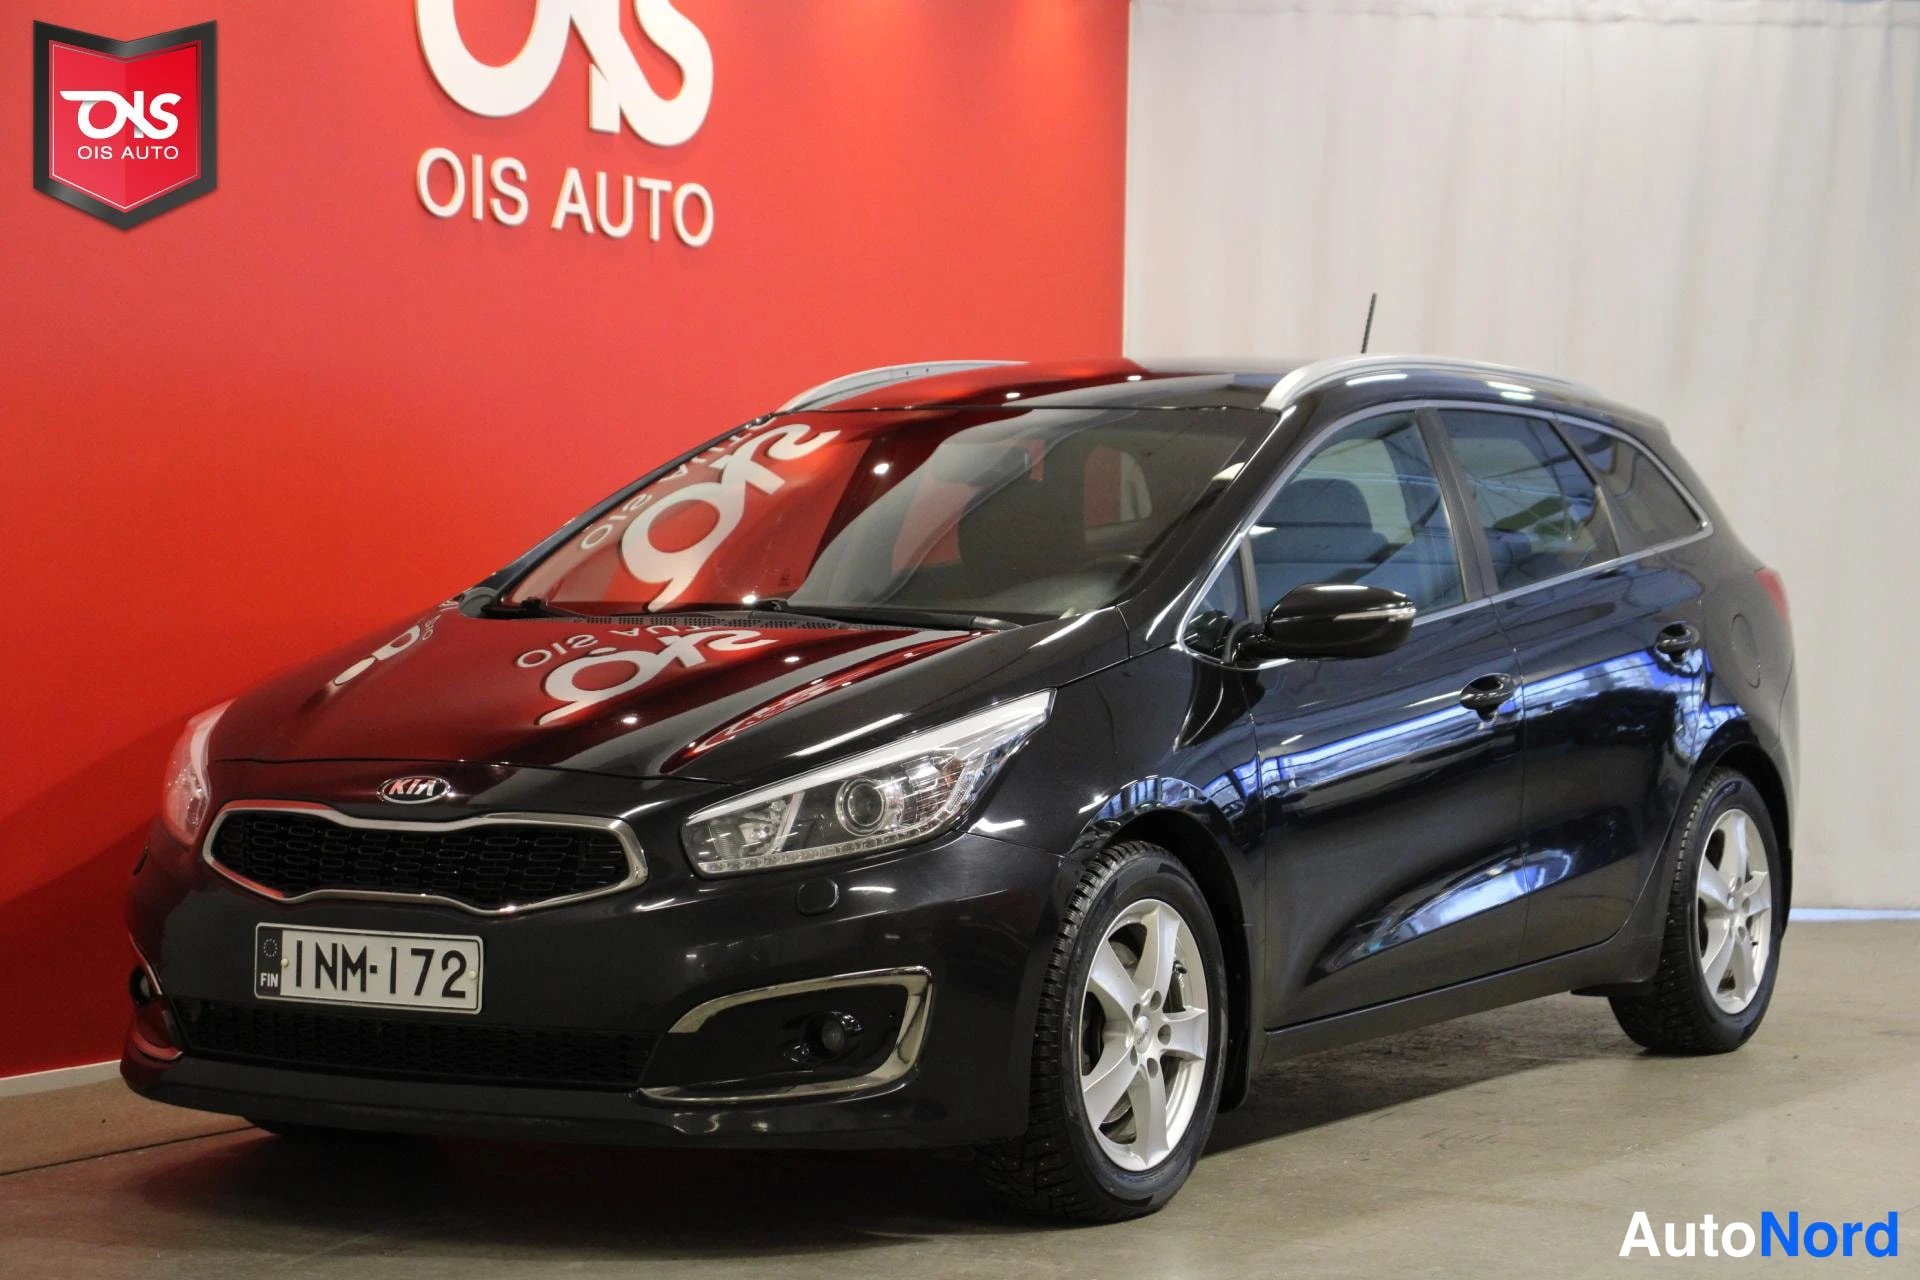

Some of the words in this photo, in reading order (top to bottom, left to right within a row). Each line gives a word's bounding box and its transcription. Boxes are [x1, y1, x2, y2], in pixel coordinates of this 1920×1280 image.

[416, 147, 529, 226] OIS
[551, 167, 714, 248] AUTO
[388, 779, 437, 797] KIA
[260, 972, 279, 988] FIN
[295, 939, 467, 999] INM-172
